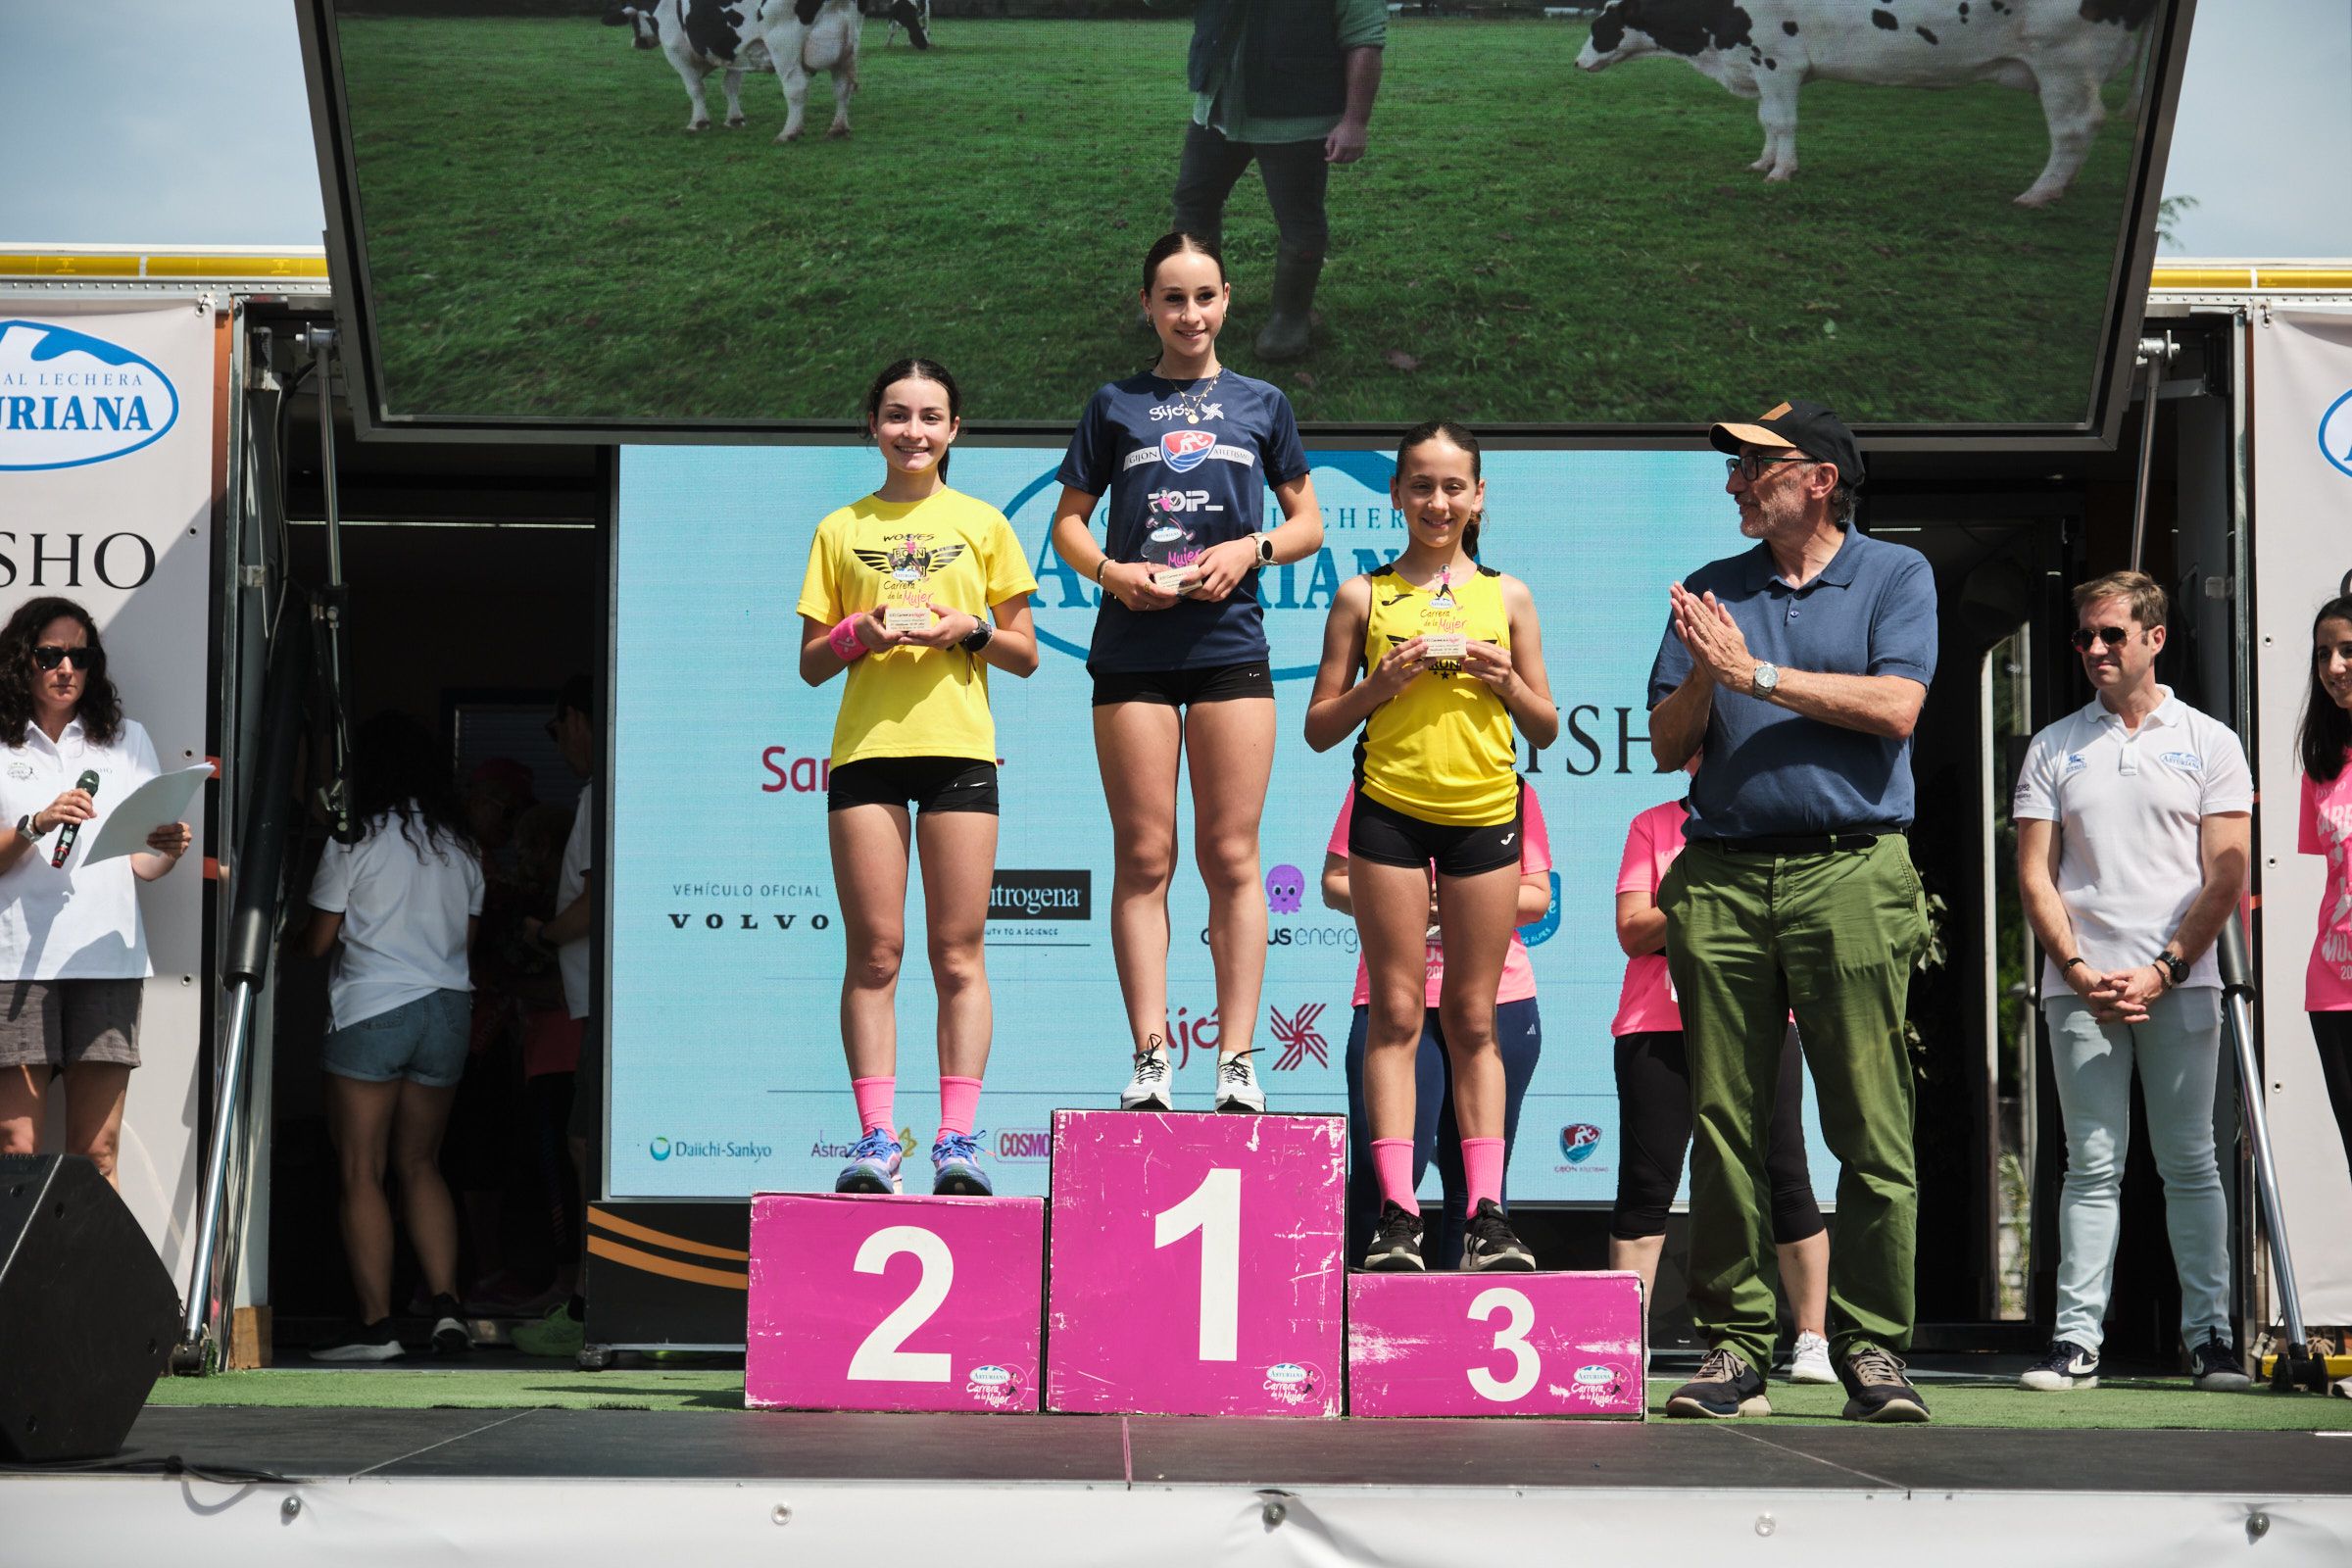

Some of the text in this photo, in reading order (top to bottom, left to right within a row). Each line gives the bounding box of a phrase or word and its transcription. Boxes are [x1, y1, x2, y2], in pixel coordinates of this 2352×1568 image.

[39, 373, 143, 386] LECHERA
[0, 395, 153, 431] RIANA
[895, 549, 924, 558] BON
[1167, 547, 1202, 568] Mujer
[883, 580, 915, 590] Carrera
[887, 589, 934, 608] de la Mujer
[1420, 609, 1450, 618] Carrera
[1439, 616, 1468, 634] Mujer
[673, 883, 822, 898] VEHÍCULO OFICIAL
[668, 913, 830, 930] VOLVO
[1295, 927, 1358, 954] energ
[675, 1141, 772, 1163] Daiichi-Sankyo
[1153, 1167, 1242, 1362] 1
[847, 1225, 955, 1383] 2
[1466, 1287, 1542, 1402] 3
[965, 1382, 1000, 1394] Carrera
[1263, 1380, 1297, 1391] Carrera
[1571, 1383, 1604, 1393] Carrera
[985, 1392, 1010, 1408] Mujer
[1282, 1390, 1307, 1406] Mujer
[1591, 1392, 1616, 1408] Mujer
